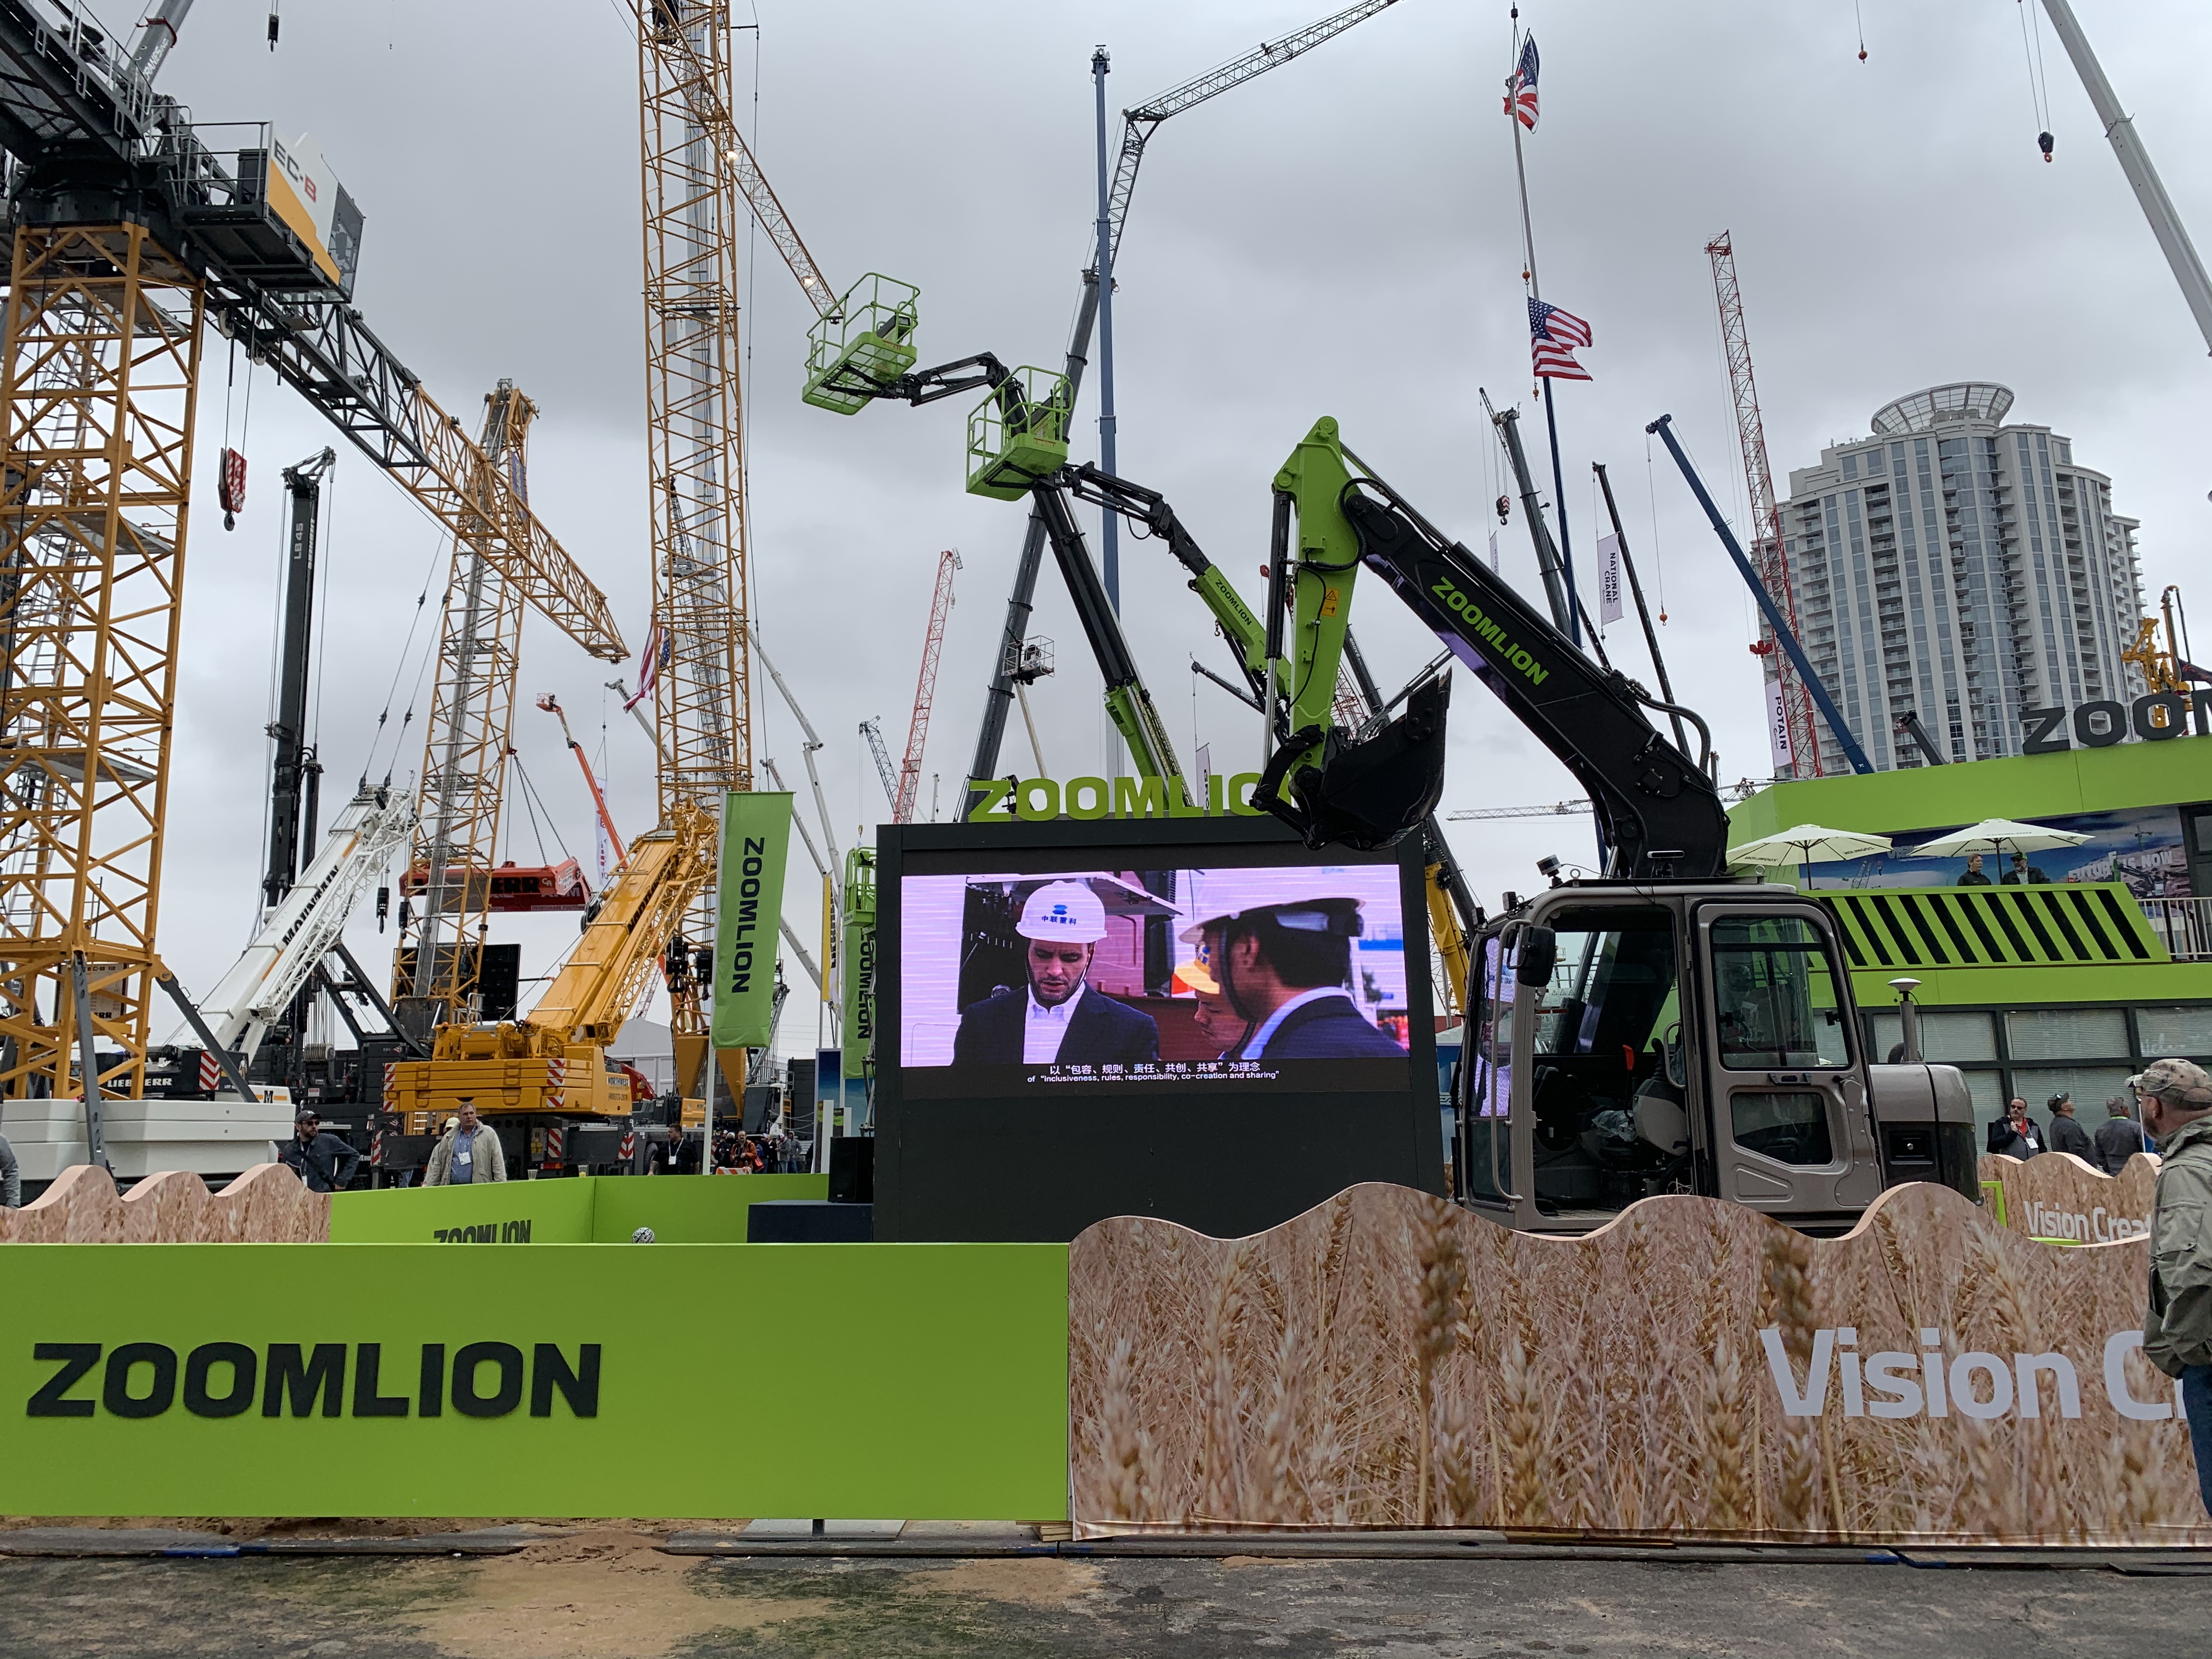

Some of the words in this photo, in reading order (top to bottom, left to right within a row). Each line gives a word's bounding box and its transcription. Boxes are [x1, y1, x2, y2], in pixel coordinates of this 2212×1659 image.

[294, 543, 302, 560] LB
[296, 522, 303, 541] 45
[1604, 570, 1612, 605] CRANE
[1610, 552, 1618, 603] NATIONAL
[1215, 579, 1252, 626] ZOOMLION
[1431, 576, 1549, 686] ZOOMLION
[1240, 692, 1256, 704] GROVE
[1775, 696, 1787, 750] POTAIN
[969, 772, 1286, 823] ZOOMLIO
[2141, 851, 2172, 868] NOW
[731, 837, 765, 994] ZOOMLION
[1041, 915, 1076, 926] 中联重科
[107, 1077, 172, 1087] LIEBERR
[1125, 1072, 1180, 1081] responsibility,
[2023, 1200, 2090, 1241] Vision
[26, 1342, 601, 1418] ZOOMLION
[1759, 1327, 2081, 1419] Vision
[2103, 1330, 2187, 1420] C
